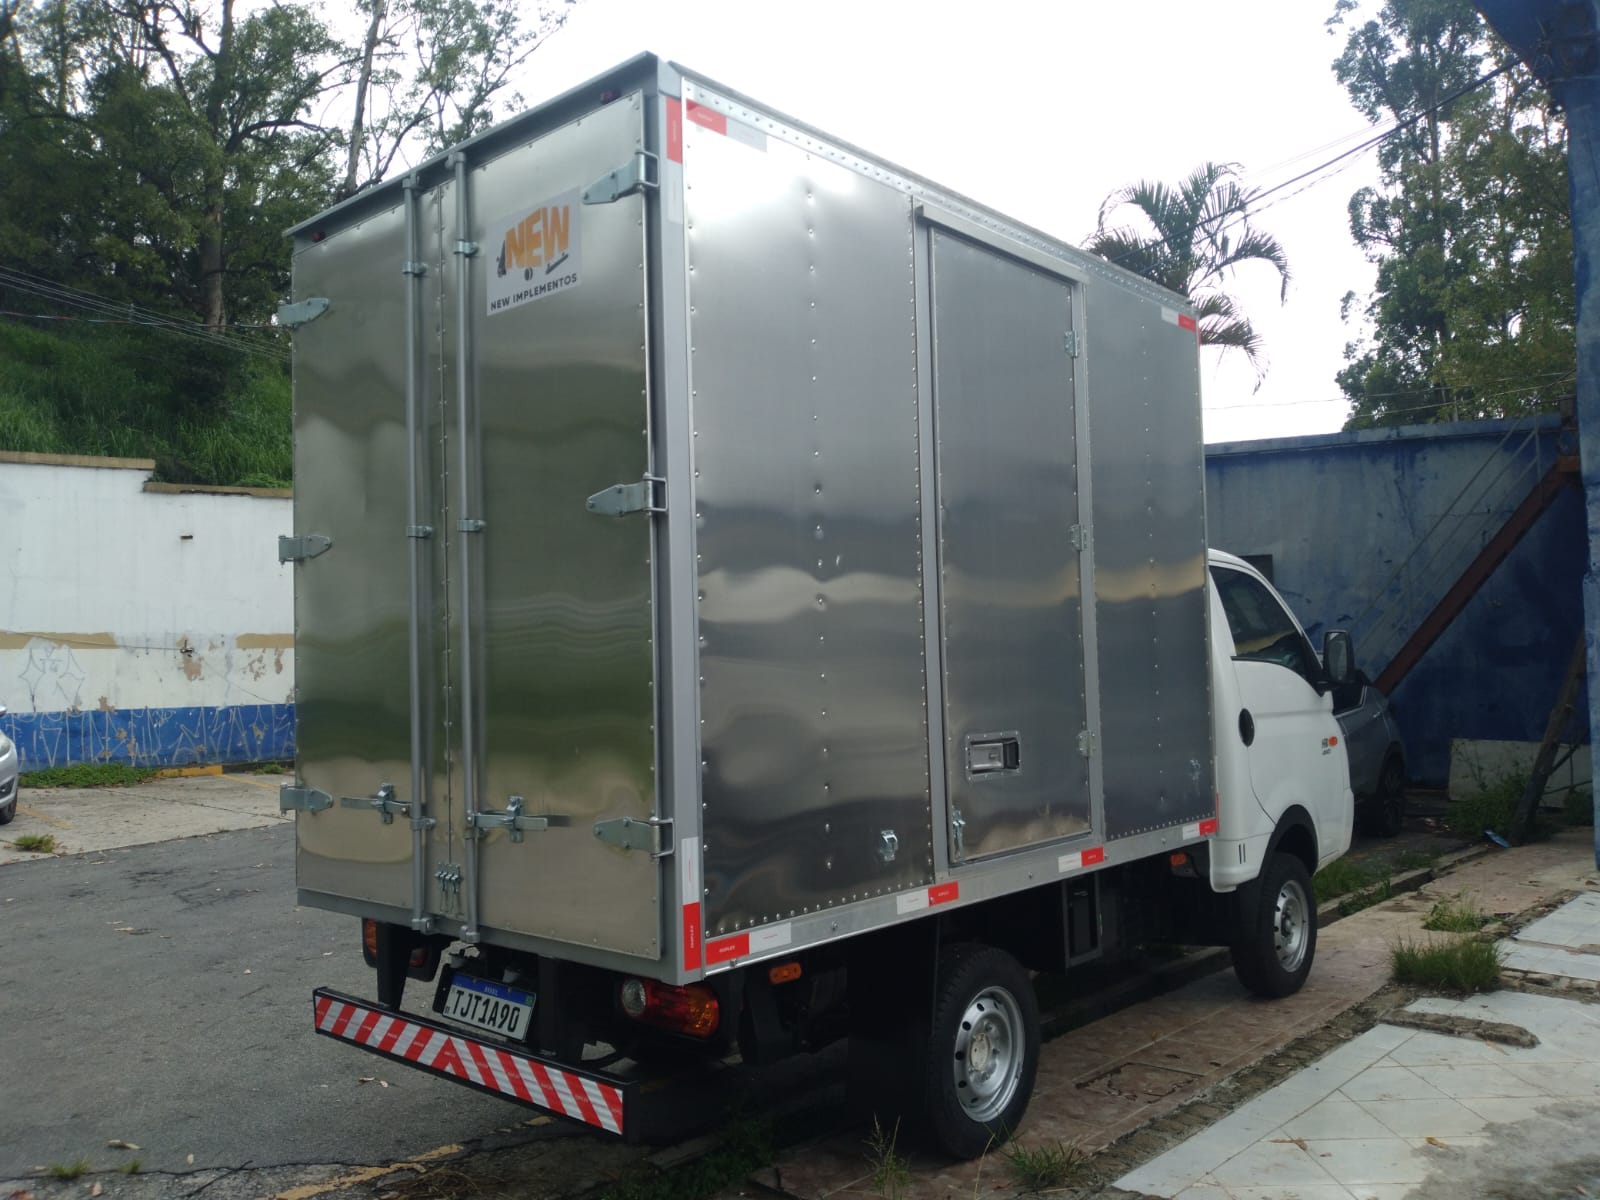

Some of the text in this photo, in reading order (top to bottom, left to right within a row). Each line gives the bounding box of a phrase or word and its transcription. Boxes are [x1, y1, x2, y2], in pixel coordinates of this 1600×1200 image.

[505, 206, 569, 270] NEW
[490, 273, 577, 312] NEW IMPLEMENTOS
[452, 989, 521, 1033] TJT1A90
